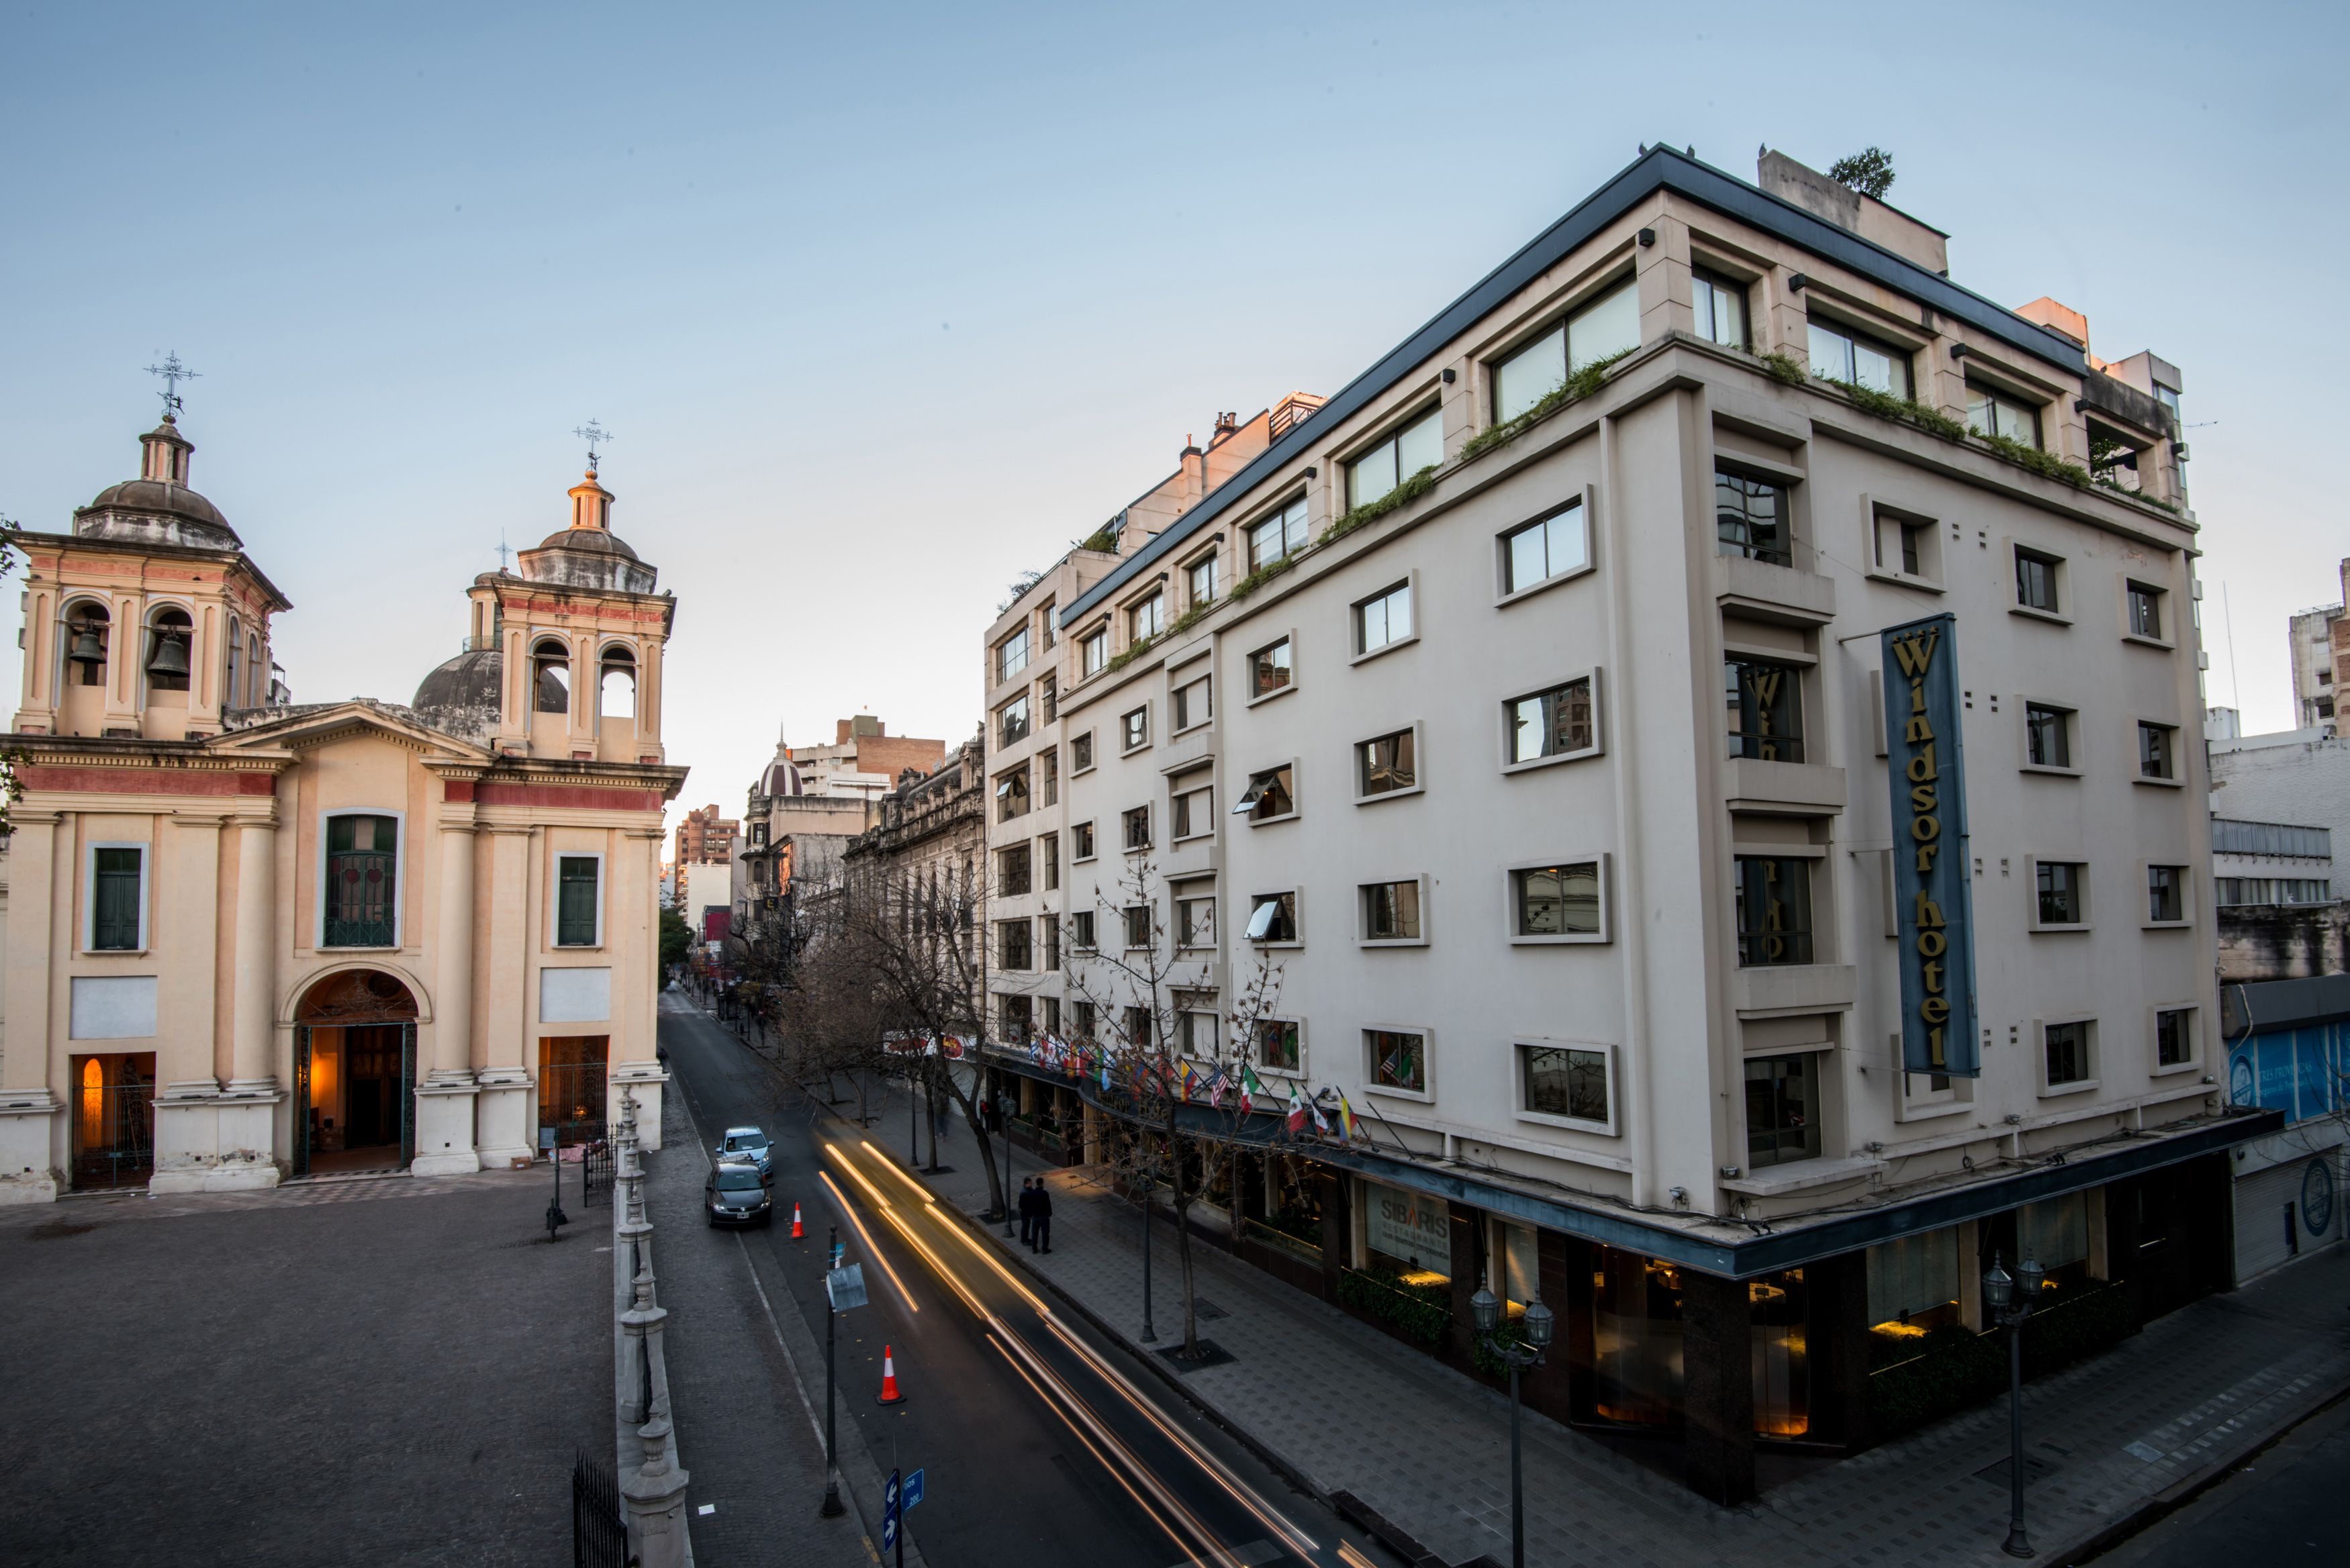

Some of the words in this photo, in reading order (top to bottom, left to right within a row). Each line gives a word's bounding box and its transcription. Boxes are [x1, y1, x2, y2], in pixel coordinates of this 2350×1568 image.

[1891, 633, 1940, 872] Windsor
[1915, 889, 1950, 1066] hotel
[2258, 1069, 2273, 1081] TRES
[2275, 1061, 2312, 1079] PROVICIAS
[1138, 1101, 1168, 1120] Hote
[1380, 1199, 1448, 1239] SIBARIS
[1381, 1220, 1448, 1252] RESTAURANTE
[1382, 1231, 1393, 1240] con
[1394, 1235, 1415, 1247] nuevas
[1415, 1243, 1450, 1261] propuestas
[909, 1493, 919, 1505] 200
